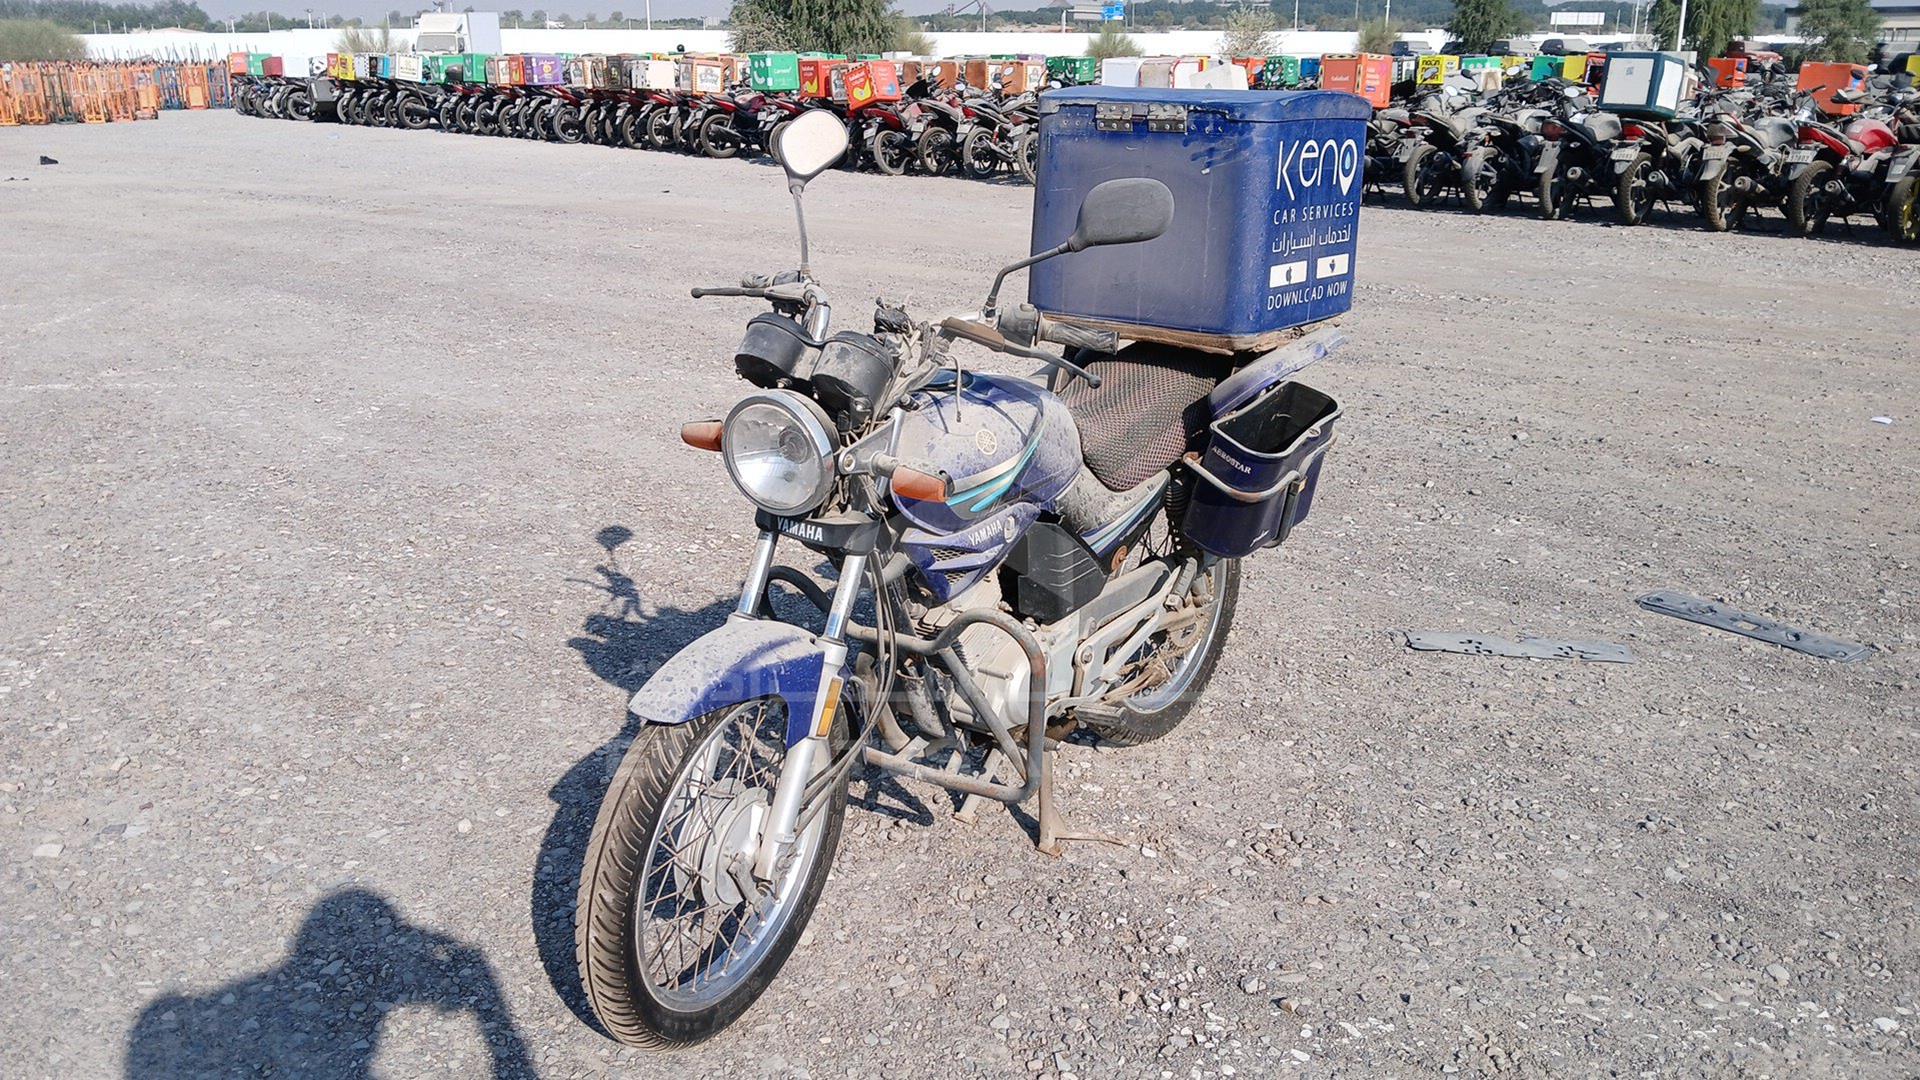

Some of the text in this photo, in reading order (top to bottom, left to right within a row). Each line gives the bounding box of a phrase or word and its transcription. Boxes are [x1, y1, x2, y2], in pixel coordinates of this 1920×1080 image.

[1274, 202, 1354, 225] CAR SERVICES
[1327, 280, 1348, 298] NOW
[1212, 446, 1252, 475] AEROSTAR
[777, 516, 824, 542] YAMAHA
[968, 519, 1003, 546] YAMAHA
